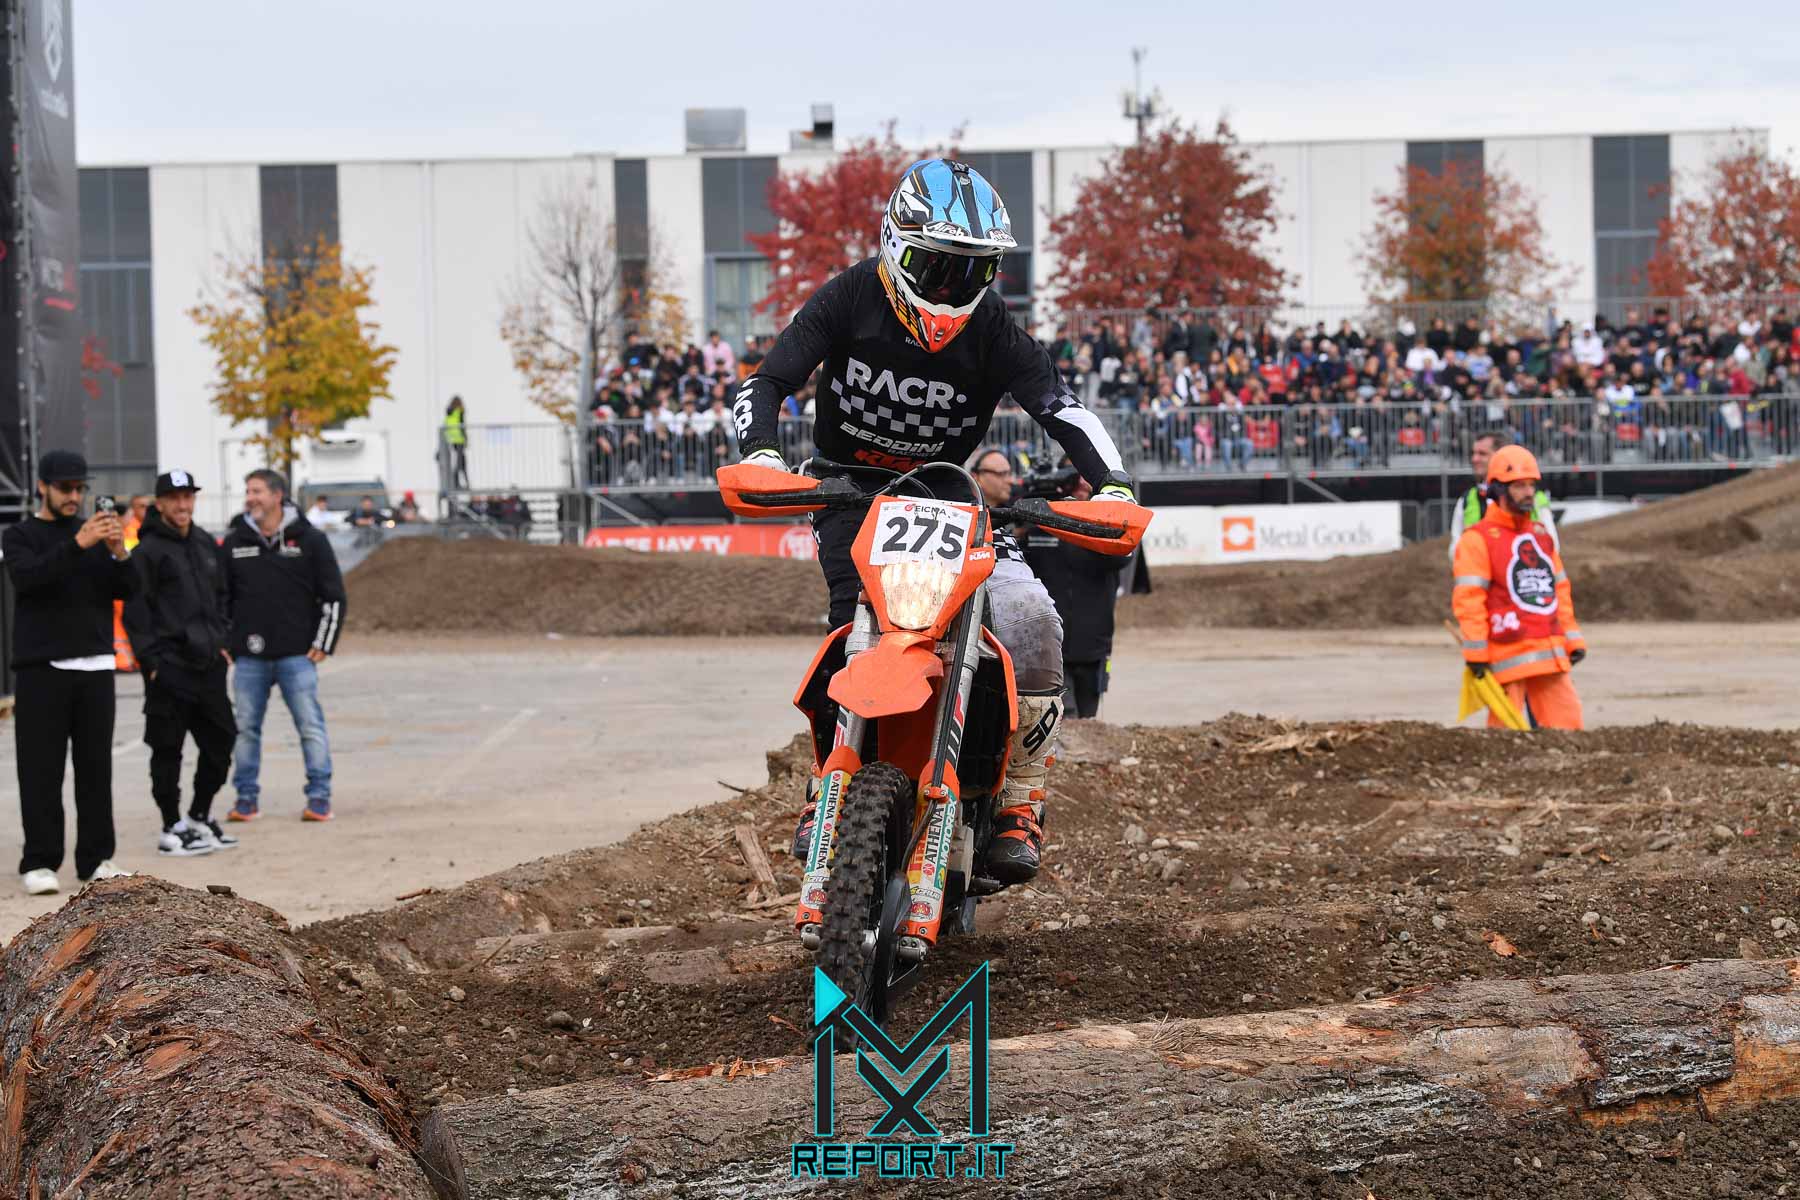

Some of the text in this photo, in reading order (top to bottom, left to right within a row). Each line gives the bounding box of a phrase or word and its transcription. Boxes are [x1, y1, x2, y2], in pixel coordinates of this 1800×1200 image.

[700, 535, 732, 556] TV
[882, 516, 965, 560] 275
[1147, 526, 1188, 550] oods
[1259, 519, 1373, 547] Metal Goods
[968, 551, 991, 562] KTM
[1491, 612, 1521, 634] 24
[825, 781, 840, 820] ATHENA
[925, 803, 945, 865] ATHENA
[939, 800, 957, 866] MOTOREX
[815, 831, 831, 870] ATHENA
